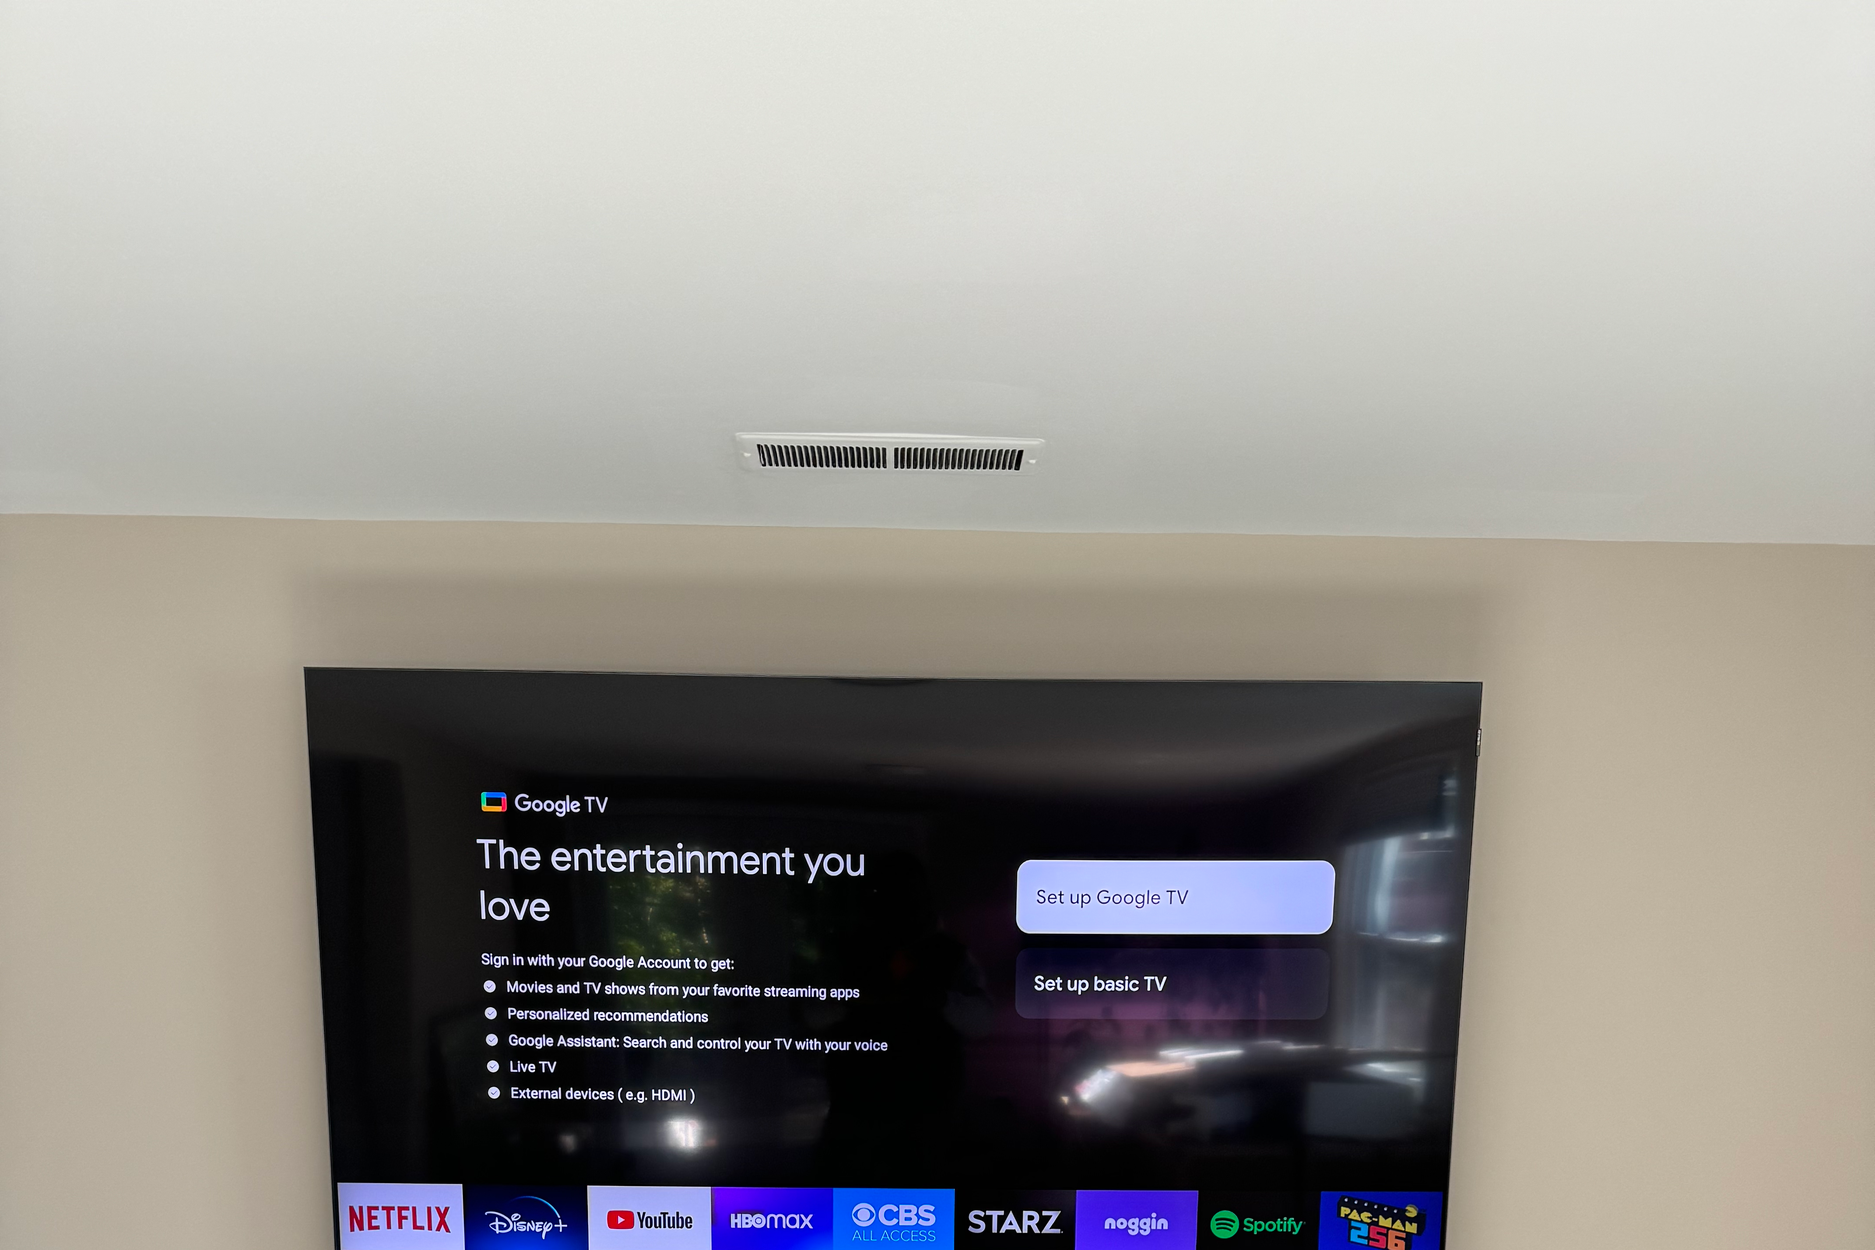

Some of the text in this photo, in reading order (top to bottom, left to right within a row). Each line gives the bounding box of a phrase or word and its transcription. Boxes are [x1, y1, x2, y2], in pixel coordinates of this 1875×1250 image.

[514, 793, 608, 818] Google TV
[476, 838, 865, 884] The entertainment you
[479, 890, 551, 921] love
[1036, 889, 1189, 908] Set up Google TV
[481, 952, 735, 973] Sign in with your Google Account to get:
[506, 981, 860, 1001] Movies and TV shows from your favorite streaming apps
[1034, 975, 1167, 995] Set up basic TV
[507, 1008, 709, 1023] Personalized recommendations
[508, 1034, 889, 1054] Google Assistant: Search and control your TV with your voice
[509, 1060, 557, 1074] Live TV
[510, 1086, 562, 1101] External
[565, 1087, 614, 1101] devices
[651, 1088, 687, 1102] HDMI
[348, 1204, 451, 1234] NETFLIX
[637, 1211, 693, 1231] YouTube
[878, 1204, 936, 1227] CBS
[968, 1209, 1062, 1234] STARZ
[1104, 1213, 1169, 1236] noggin
[1340, 1206, 1418, 1234] PAC-MAN
[852, 1229, 936, 1242] ALL ACCESS
[1243, 1217, 1303, 1235] Spotify
